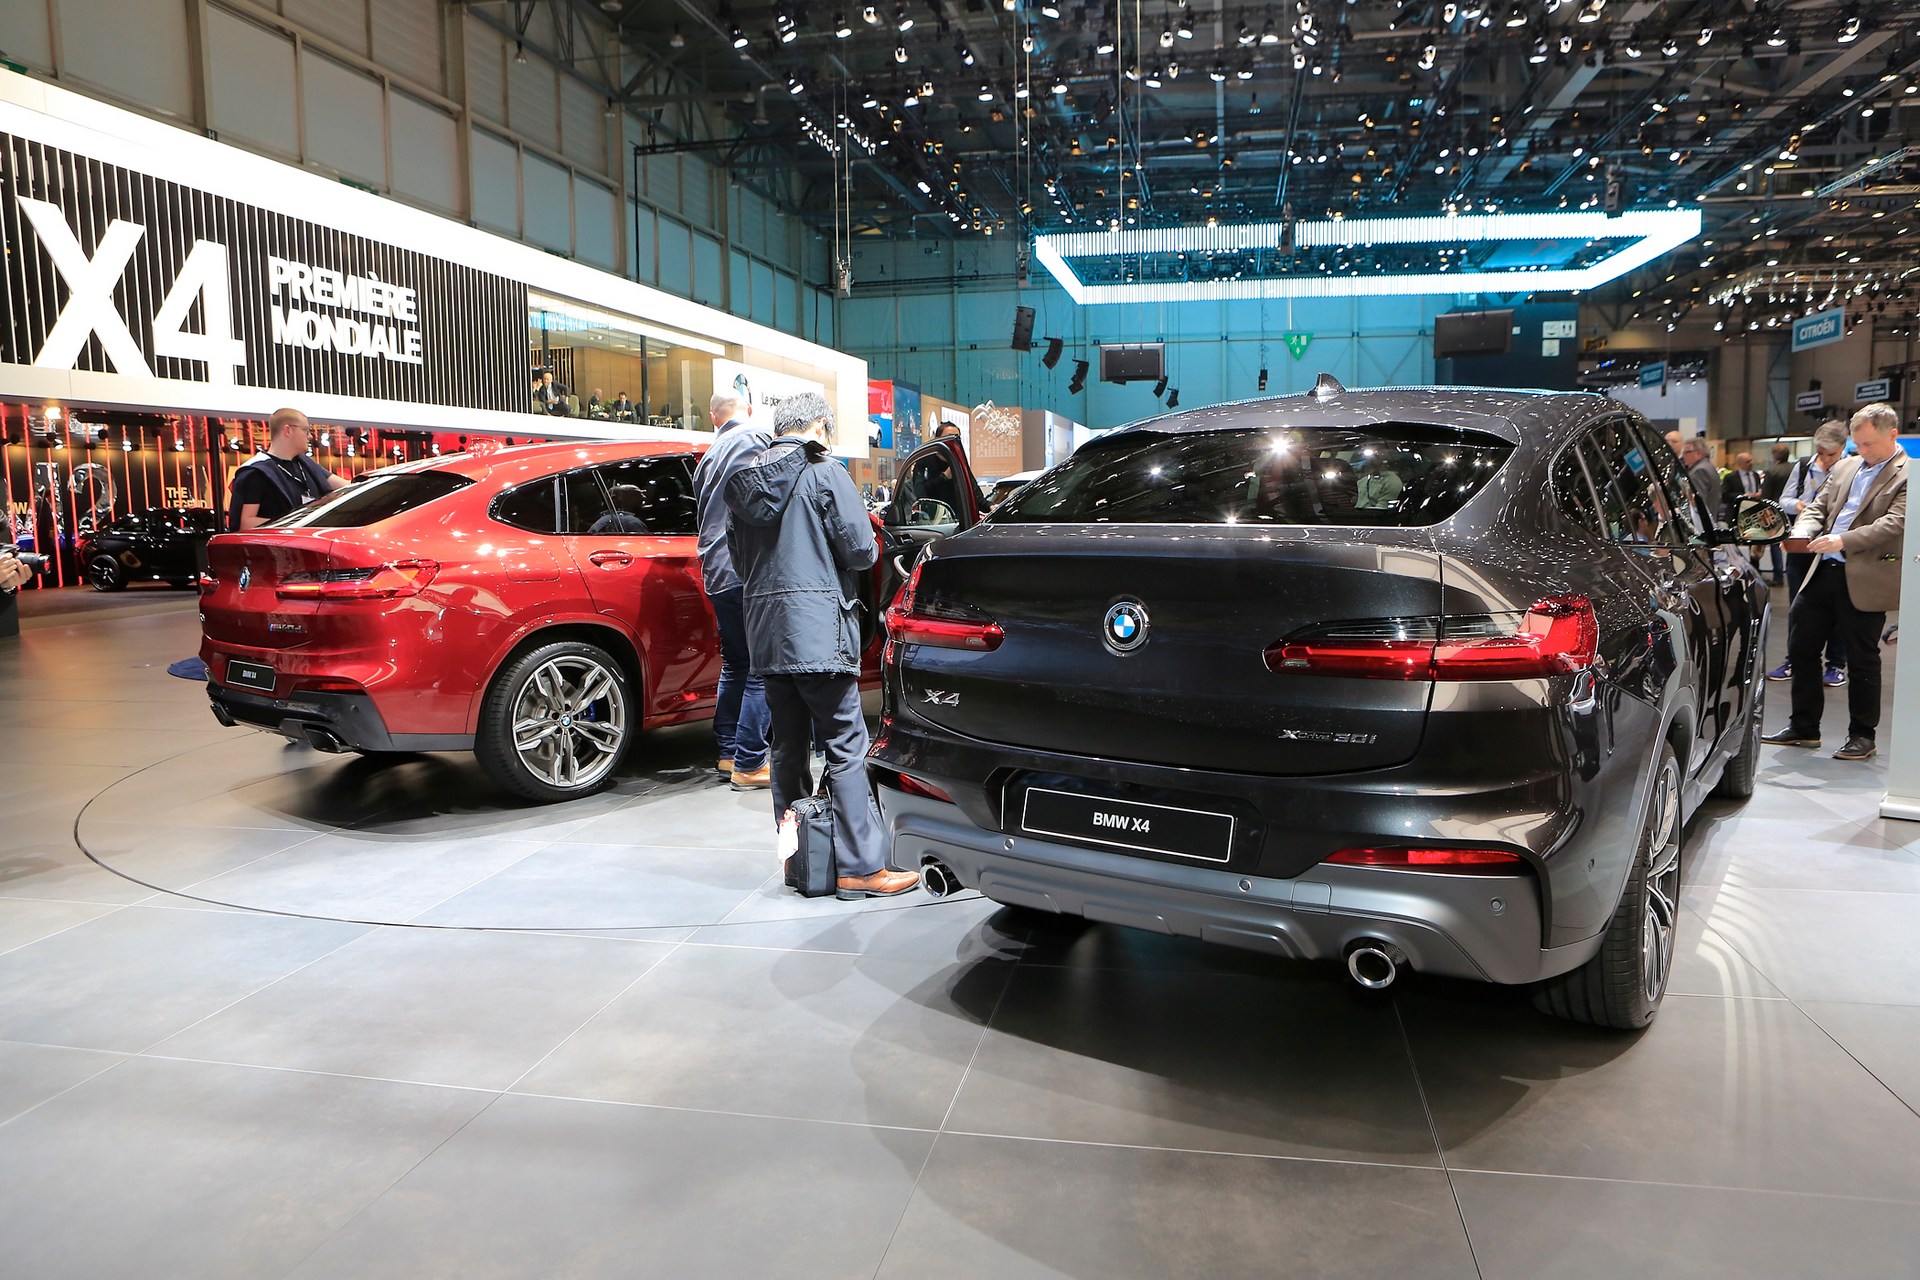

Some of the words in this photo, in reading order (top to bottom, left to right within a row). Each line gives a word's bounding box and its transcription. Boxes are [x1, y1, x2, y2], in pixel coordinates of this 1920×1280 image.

[16, 195, 246, 386] X4
[268, 255, 417, 322] PREMIÈRE
[272, 305, 422, 365] MONDIALE
[1800, 319, 1836, 340] CITROËN
[166, 487, 188, 498] THE
[920, 688, 960, 707] X4
[1333, 733, 1377, 744] 30i
[1093, 812, 1130, 830] BMW
[1131, 817, 1150, 833] X4
